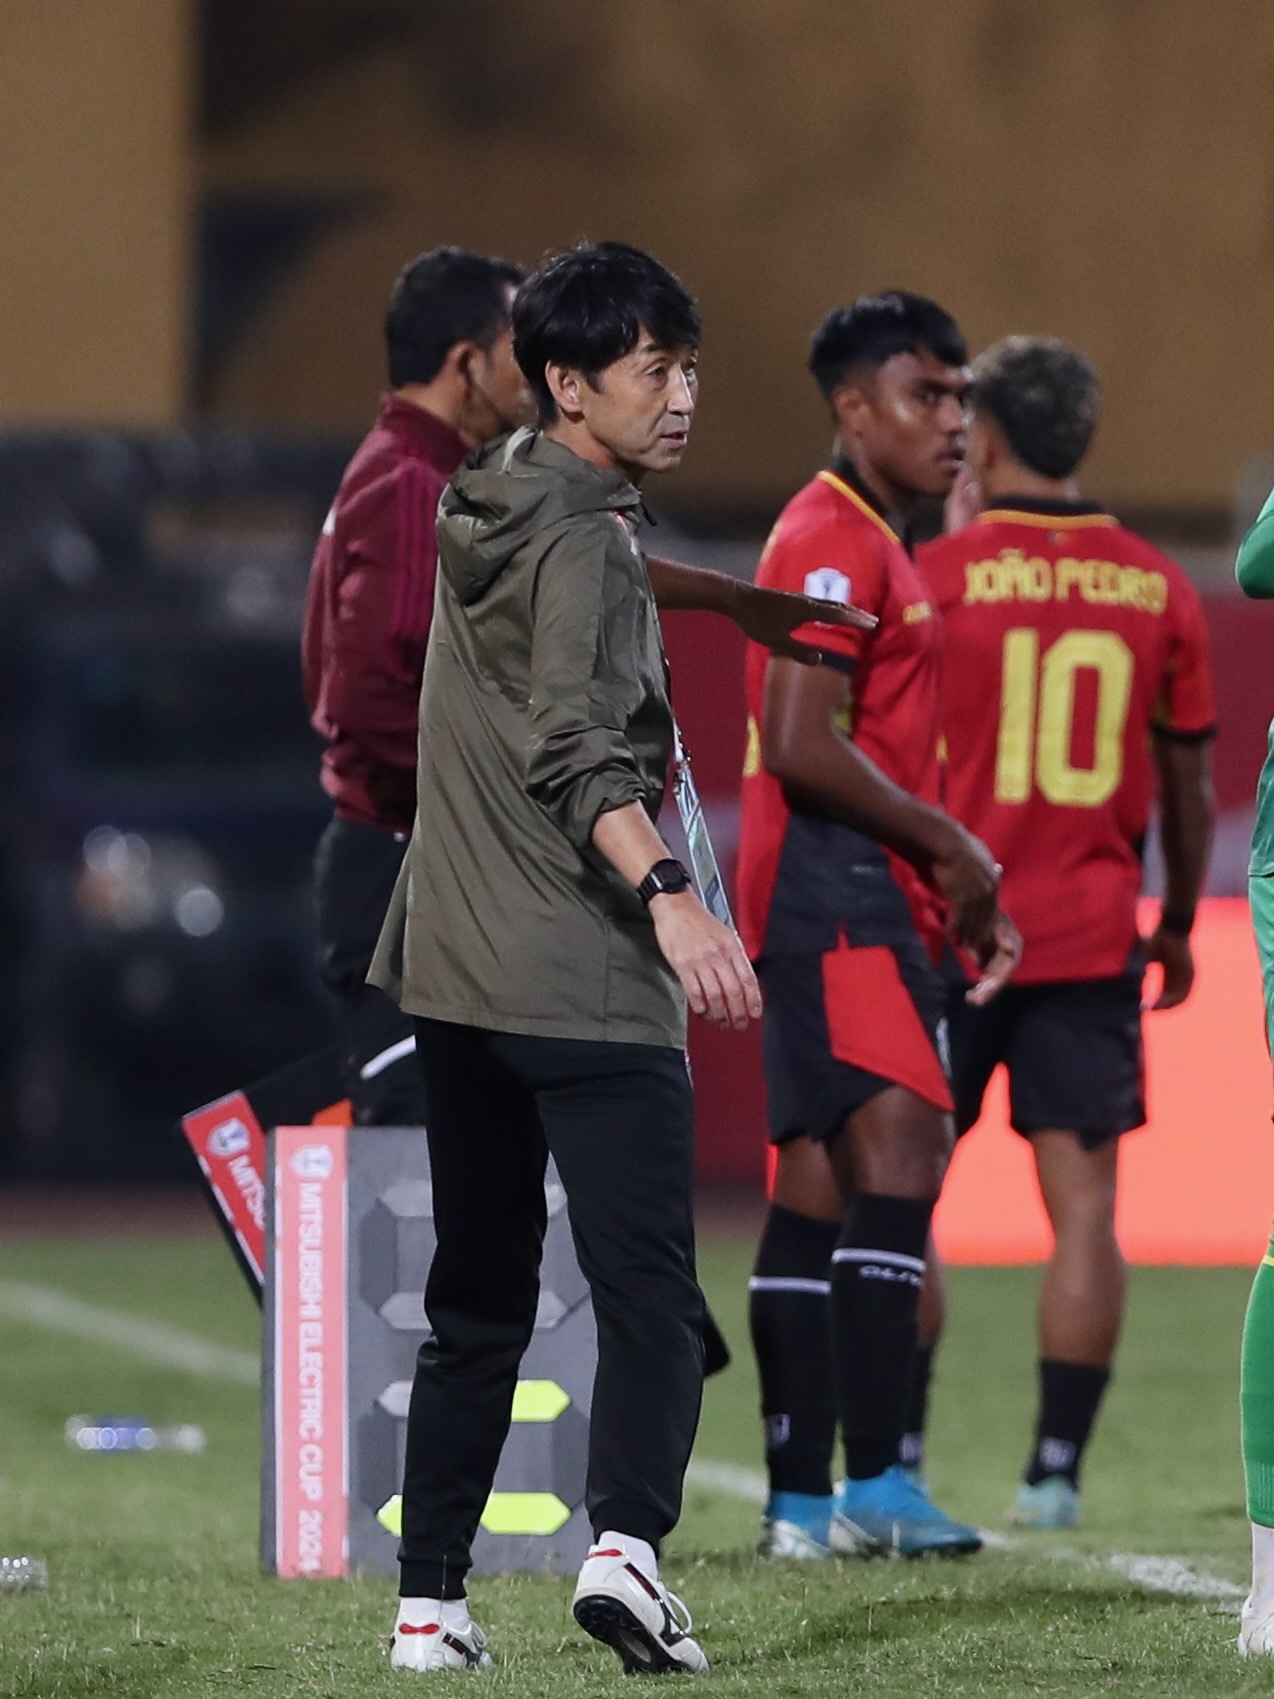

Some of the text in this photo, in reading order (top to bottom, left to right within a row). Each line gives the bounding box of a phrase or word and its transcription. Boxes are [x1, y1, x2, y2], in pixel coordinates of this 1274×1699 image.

[962, 547, 1053, 606] JOÃO
[994, 627, 1134, 808] 10
[299, 1182, 323, 1572] MITSUBISHI ELECTRIC CUP 2024
